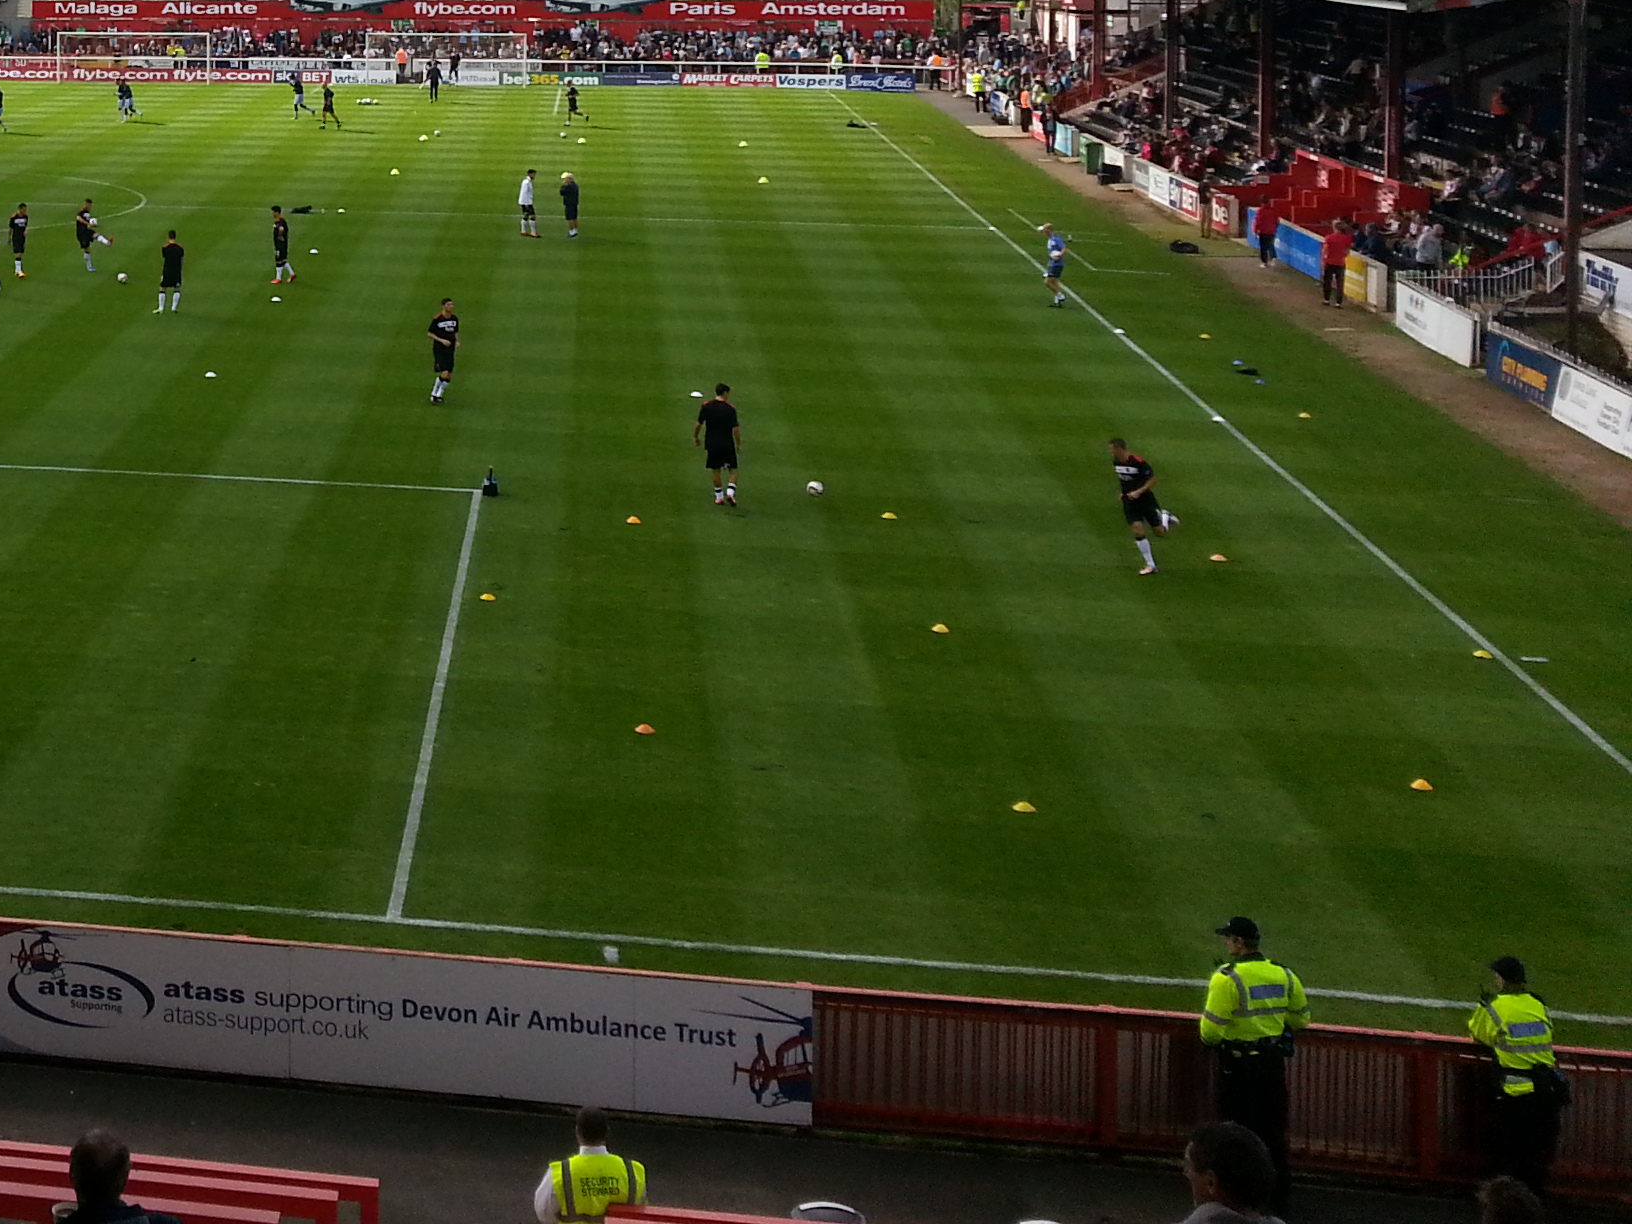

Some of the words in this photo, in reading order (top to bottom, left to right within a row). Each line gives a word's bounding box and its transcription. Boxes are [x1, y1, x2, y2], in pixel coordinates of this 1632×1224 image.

[55, 2, 138, 17] Malaga
[161, 1, 258, 15] Alicante
[414, 2, 516, 17] flybe.com
[669, 2, 736, 16] Paris
[761, 2, 905, 16] Amsterdam
[72, 68, 168, 80] flybe.com
[172, 69, 270, 81] flybe.com
[302, 72, 330, 82] BET
[503, 73, 599, 85] bet365.com
[683, 74, 728, 84] MARKET
[729, 74, 774, 85] CARPETS
[778, 75, 844, 88] Vospers
[37, 978, 123, 1002] atass
[70, 999, 123, 1015] Supporting
[163, 980, 245, 1004] atass
[254, 989, 394, 1022] supporting
[401, 998, 478, 1025] Devon
[485, 1006, 521, 1028] Air
[527, 1009, 667, 1042] Ambulance
[674, 1022, 737, 1048] Trust
[163, 1004, 369, 1041] atass-support.co.uk
[579, 1177, 619, 1187] SECURITY
[581, 1186, 620, 1197] STEWARD
